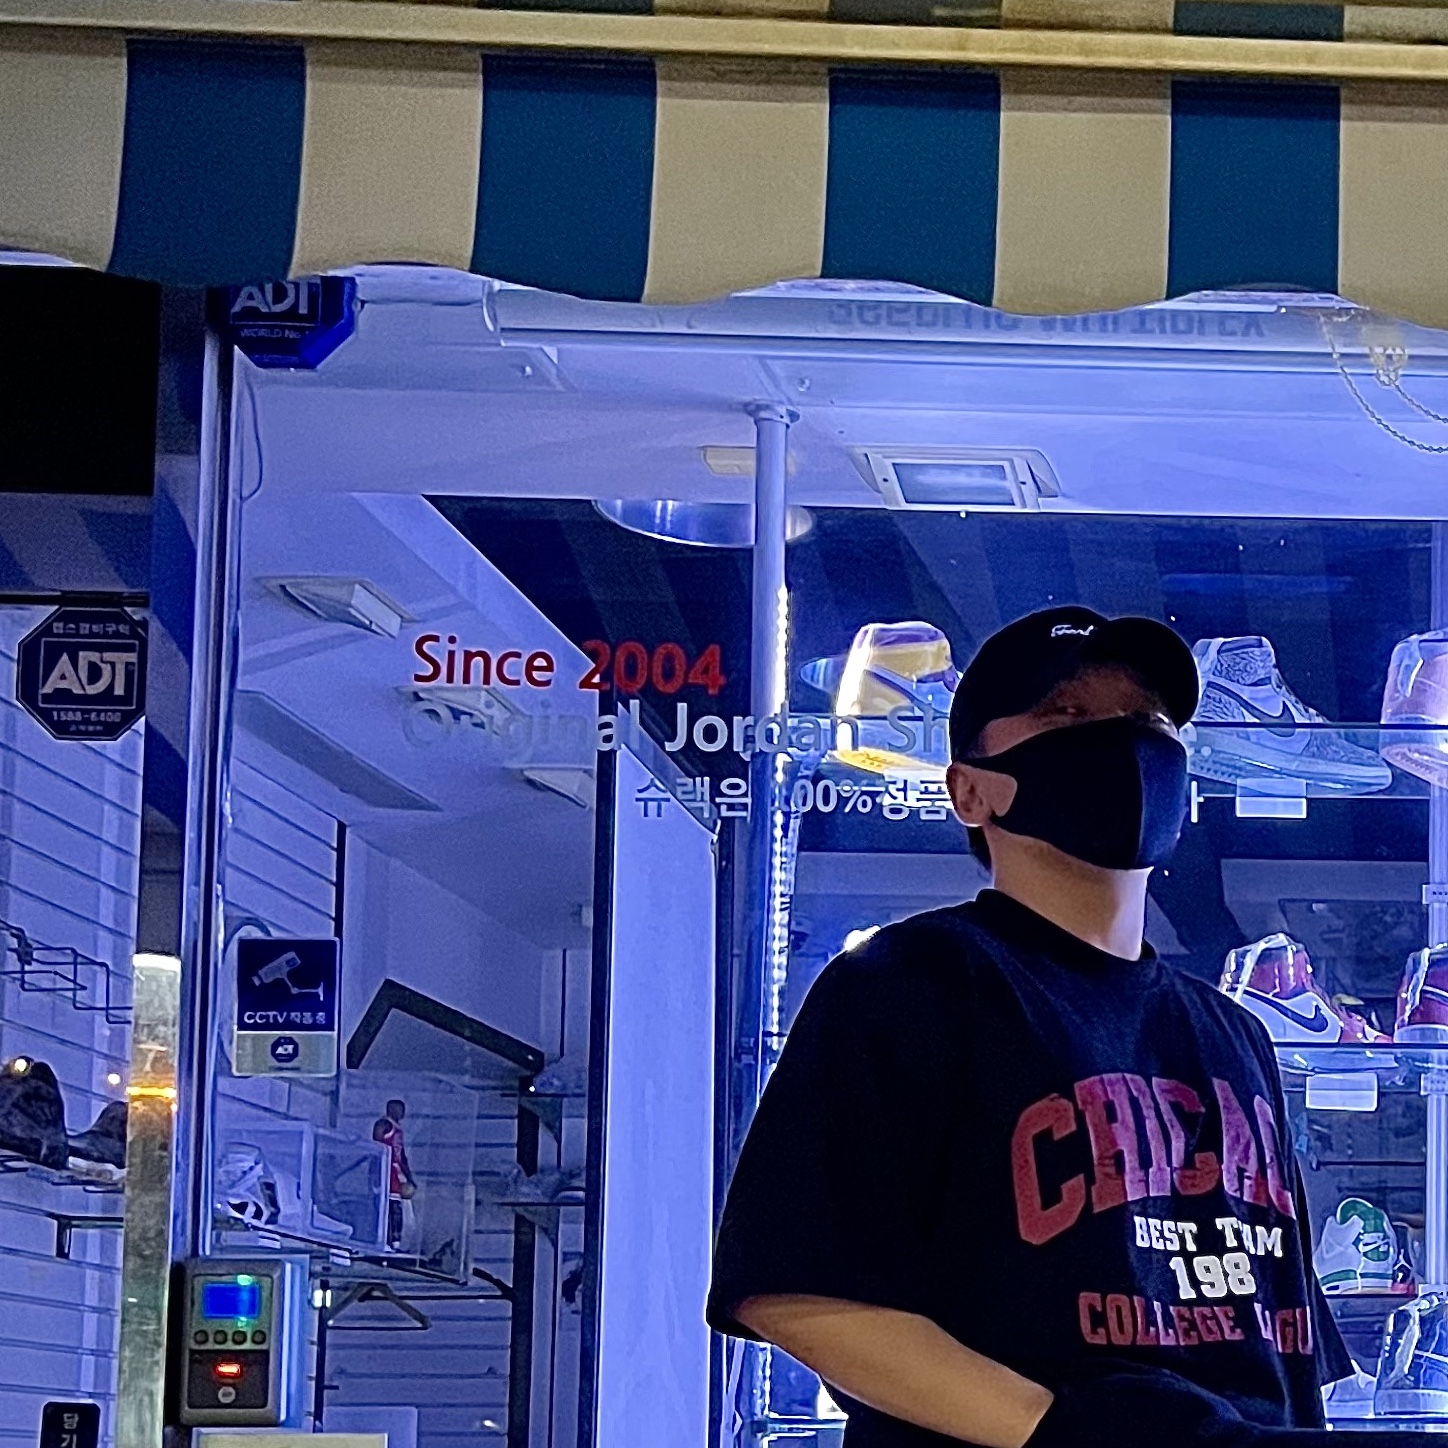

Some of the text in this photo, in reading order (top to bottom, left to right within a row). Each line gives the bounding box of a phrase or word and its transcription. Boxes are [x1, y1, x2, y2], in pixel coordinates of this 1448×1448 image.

[231, 277, 320, 314] ADT
[40, 650, 138, 696] ADT
[413, 634, 727, 695] Since 2004
[402, 698, 641, 767] Original
[664, 699, 860, 754] Jordan
[243, 1010, 288, 1025] CCTV
[1133, 1214, 1284, 1259] BEST TAM
[1078, 1291, 1246, 1346] COLLEGE
